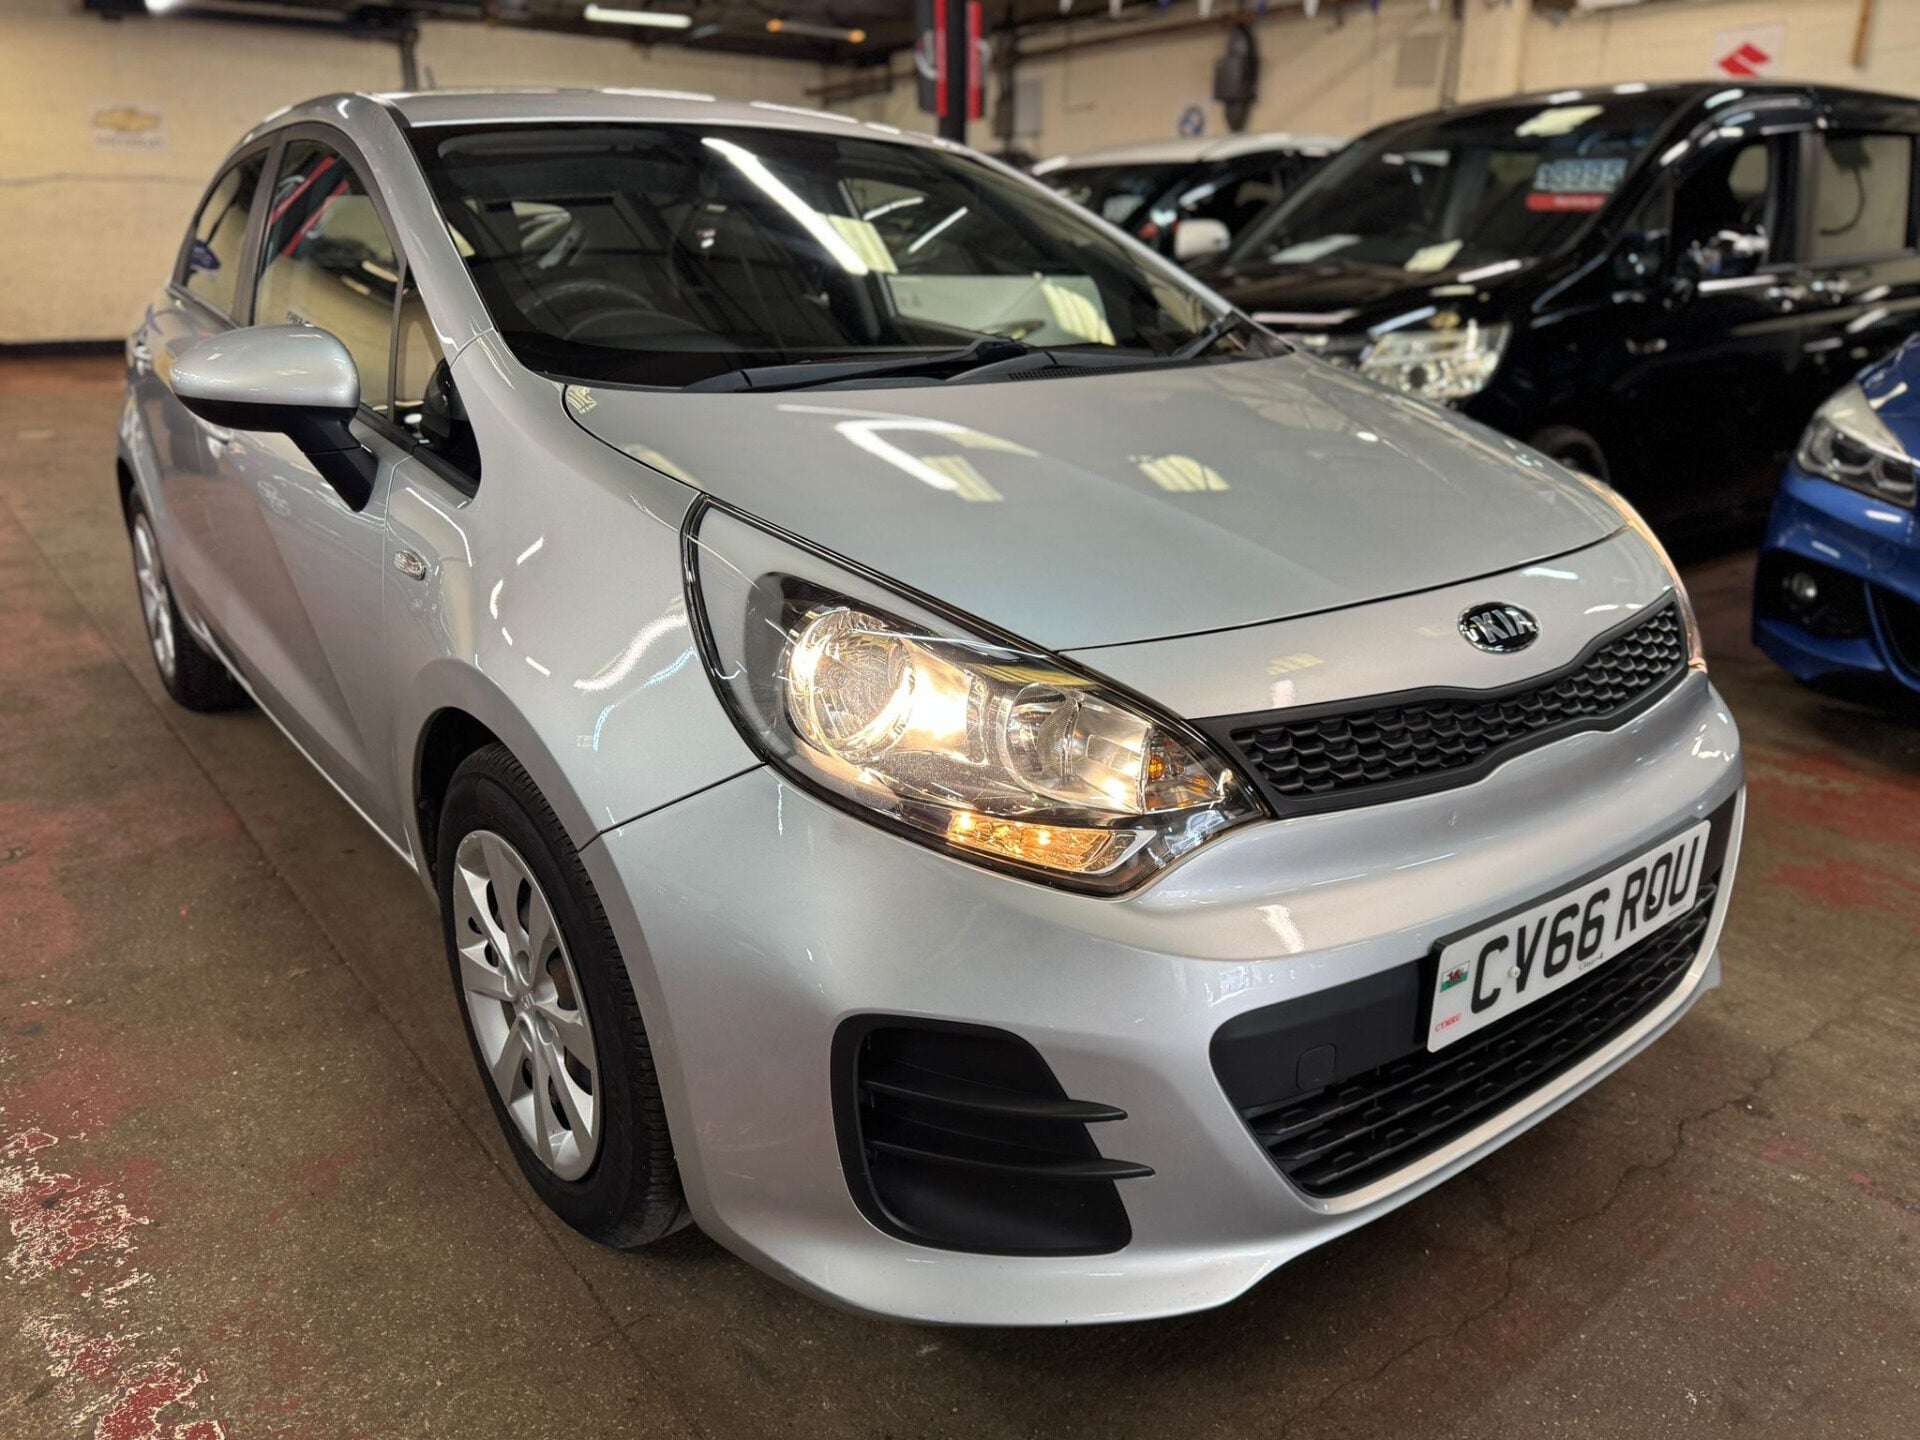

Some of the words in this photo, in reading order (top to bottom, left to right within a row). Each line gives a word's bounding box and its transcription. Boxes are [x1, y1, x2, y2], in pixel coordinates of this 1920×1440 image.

[1469, 607, 1537, 644] KIA
[1470, 887, 1611, 1014] CV66
[1614, 835, 1700, 941] ROU
